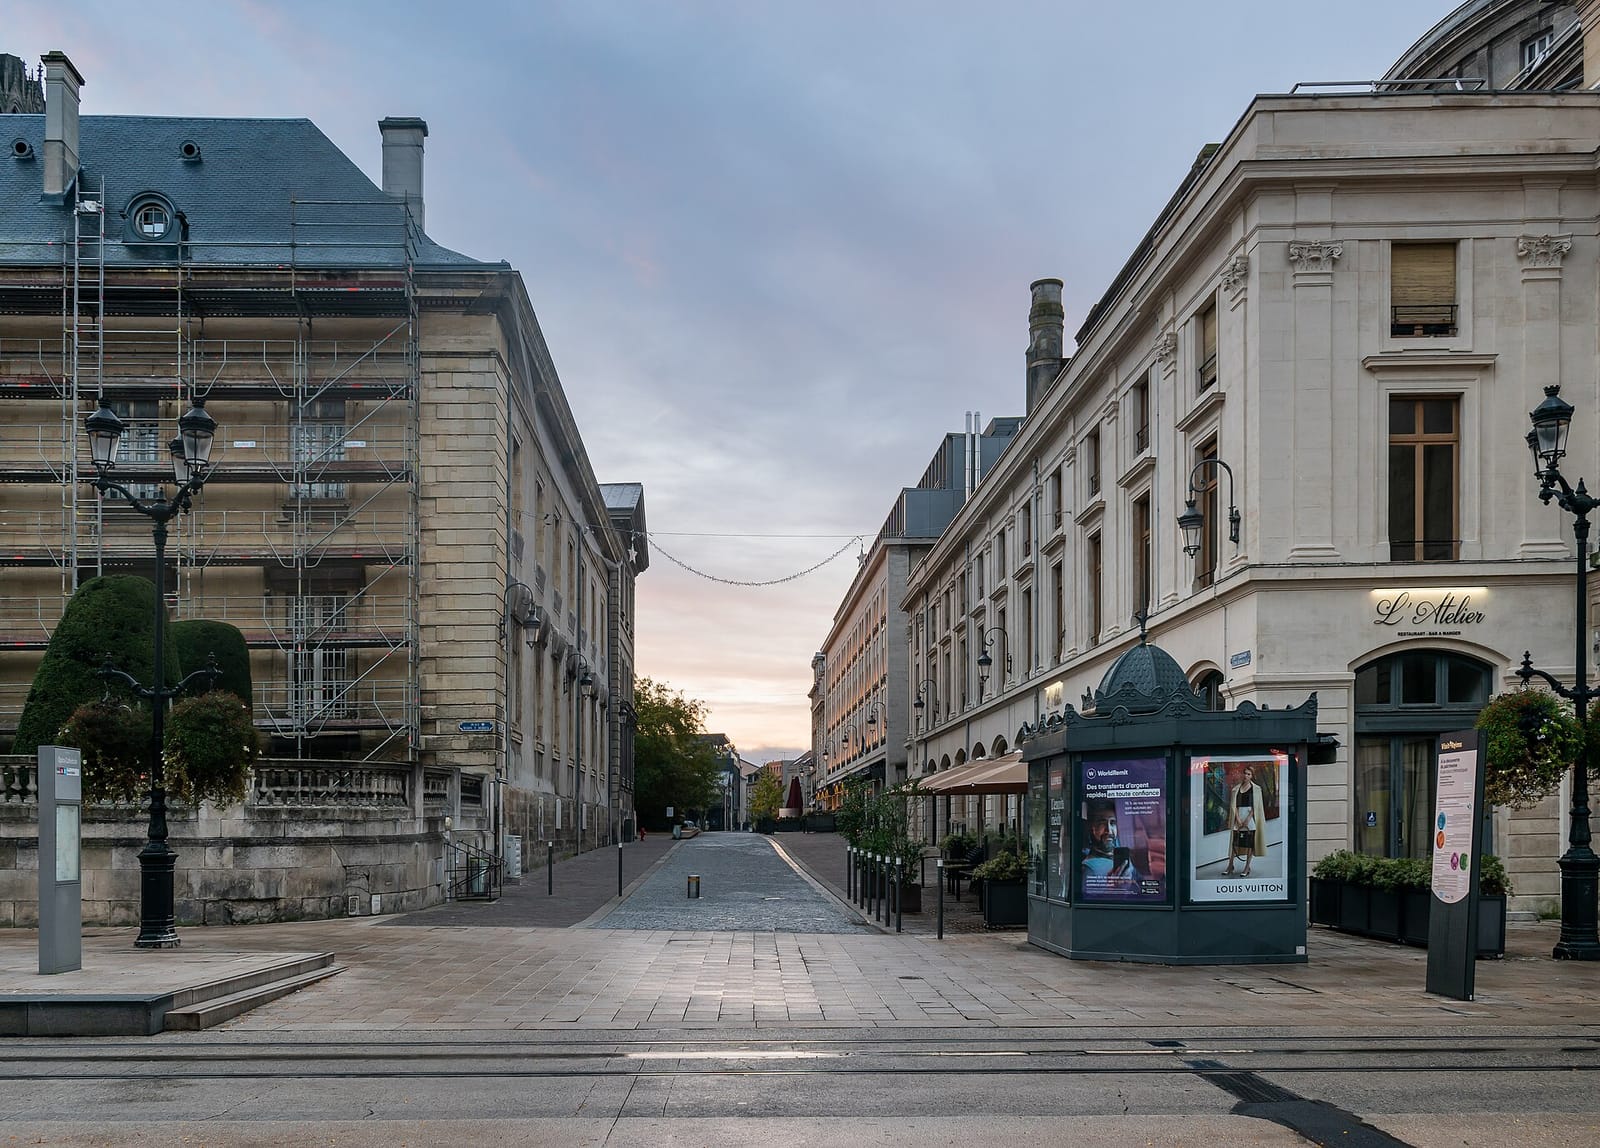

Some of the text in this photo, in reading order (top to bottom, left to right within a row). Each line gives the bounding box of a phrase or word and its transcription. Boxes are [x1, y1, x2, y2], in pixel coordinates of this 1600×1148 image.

[1374, 592, 1486, 626] L'Atelier
[1125, 782, 1149, 790] d'argent
[1086, 791, 1107, 799] rapides
[1216, 884, 1283, 894] LOUIS VUITTON
